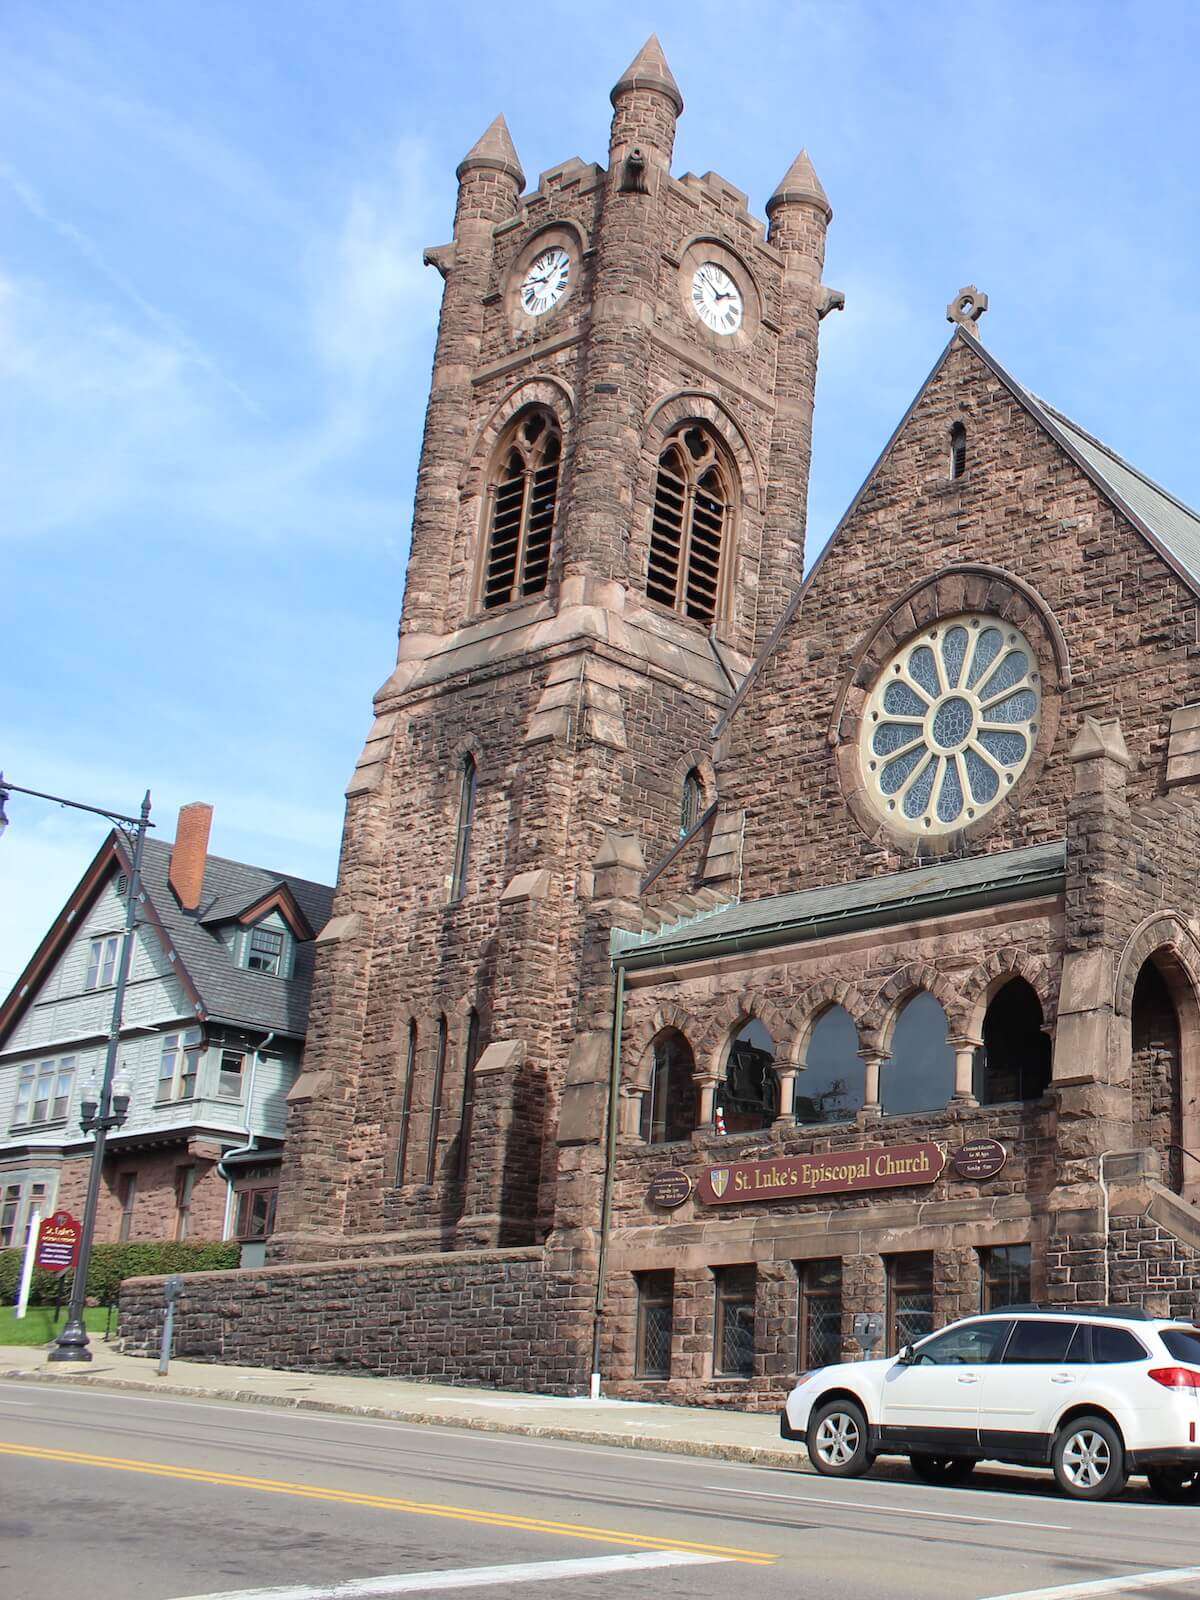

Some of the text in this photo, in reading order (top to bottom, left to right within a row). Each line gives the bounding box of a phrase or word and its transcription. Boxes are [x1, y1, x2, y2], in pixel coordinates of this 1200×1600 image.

[735, 1151, 930, 1191] St. Luke's Episcopal Church
